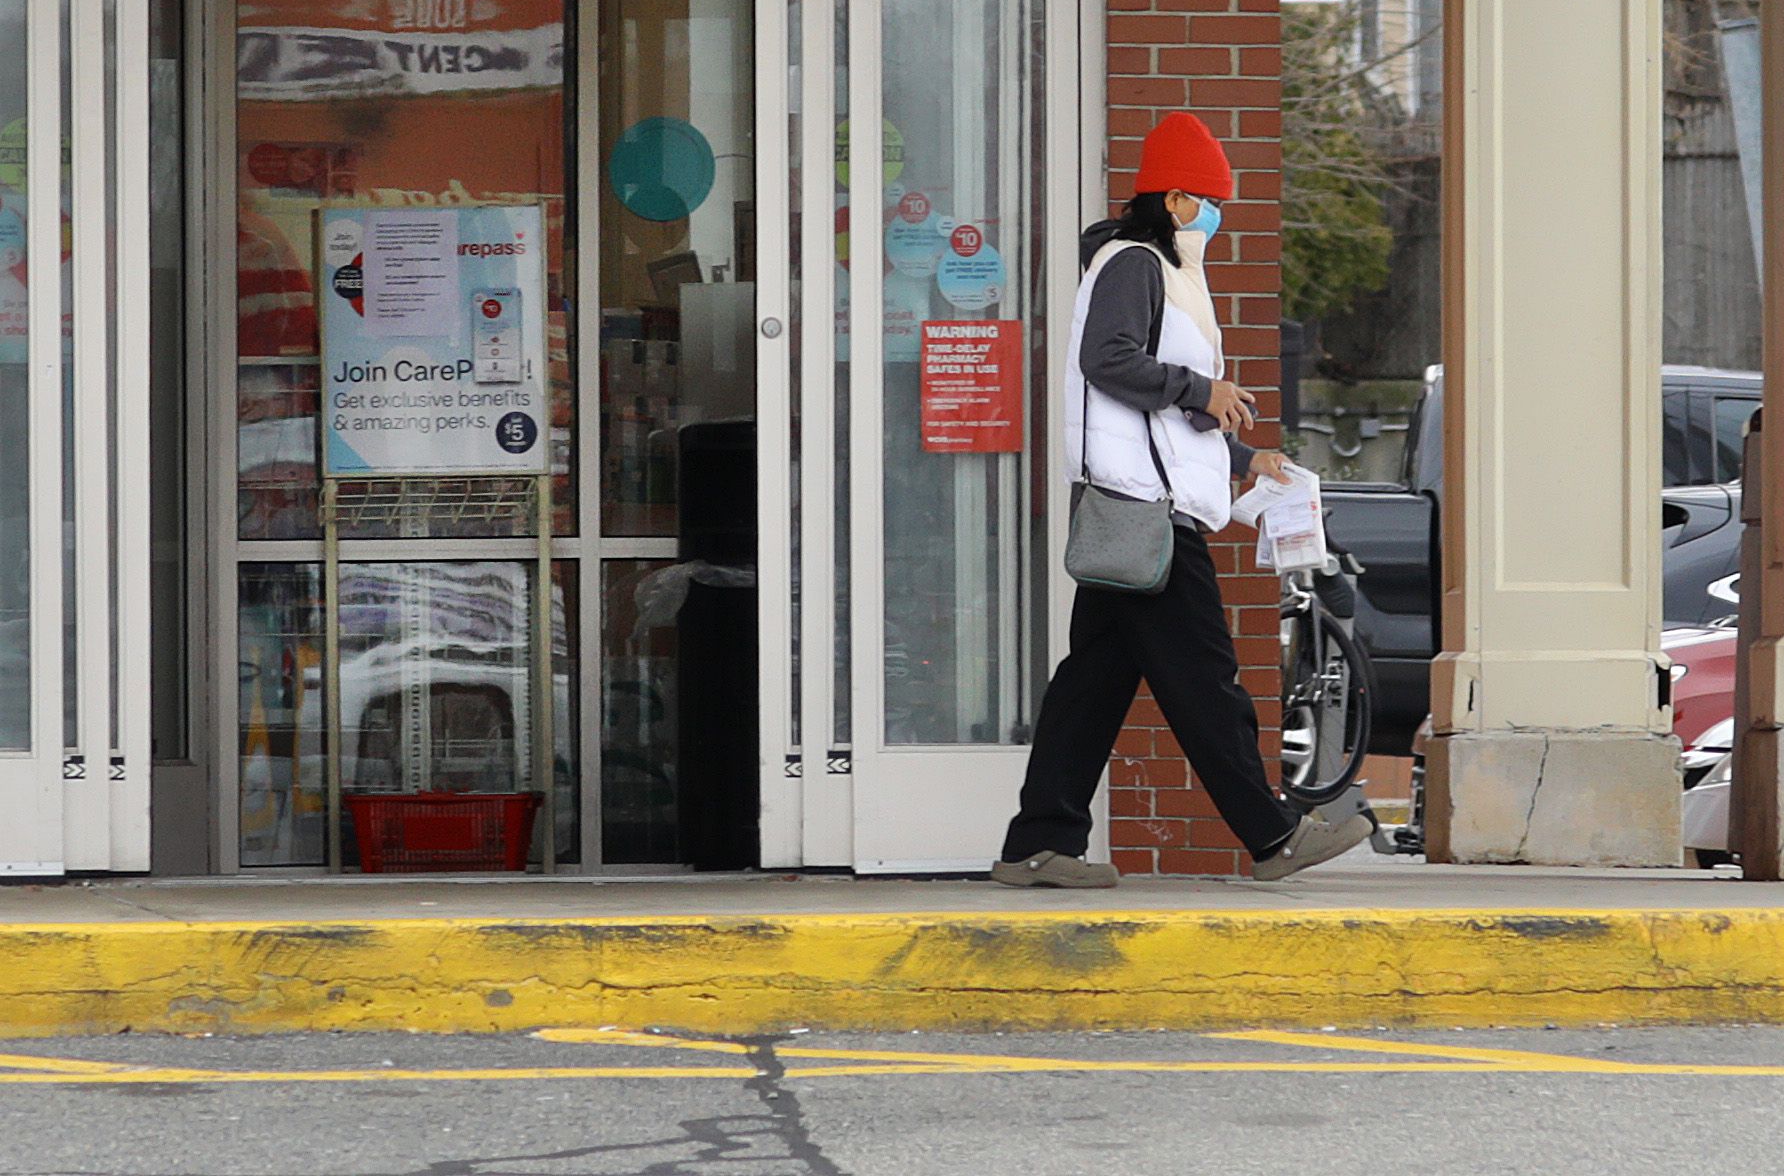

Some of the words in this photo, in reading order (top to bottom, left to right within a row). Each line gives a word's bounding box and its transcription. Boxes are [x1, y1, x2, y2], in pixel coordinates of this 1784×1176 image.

[926, 326, 999, 338] WARNING
[926, 355, 987, 363] PHARMACY
[334, 361, 387, 383] Join
[926, 365, 961, 374] SAFES
[963, 365, 975, 374] IN
[977, 365, 999, 374] USE
[333, 392, 366, 409] Get
[370, 390, 454, 408] exclusive
[458, 389, 531, 407] benefits
[333, 414, 348, 431] &
[353, 413, 430, 434] amazing
[435, 412, 491, 432] perks.
